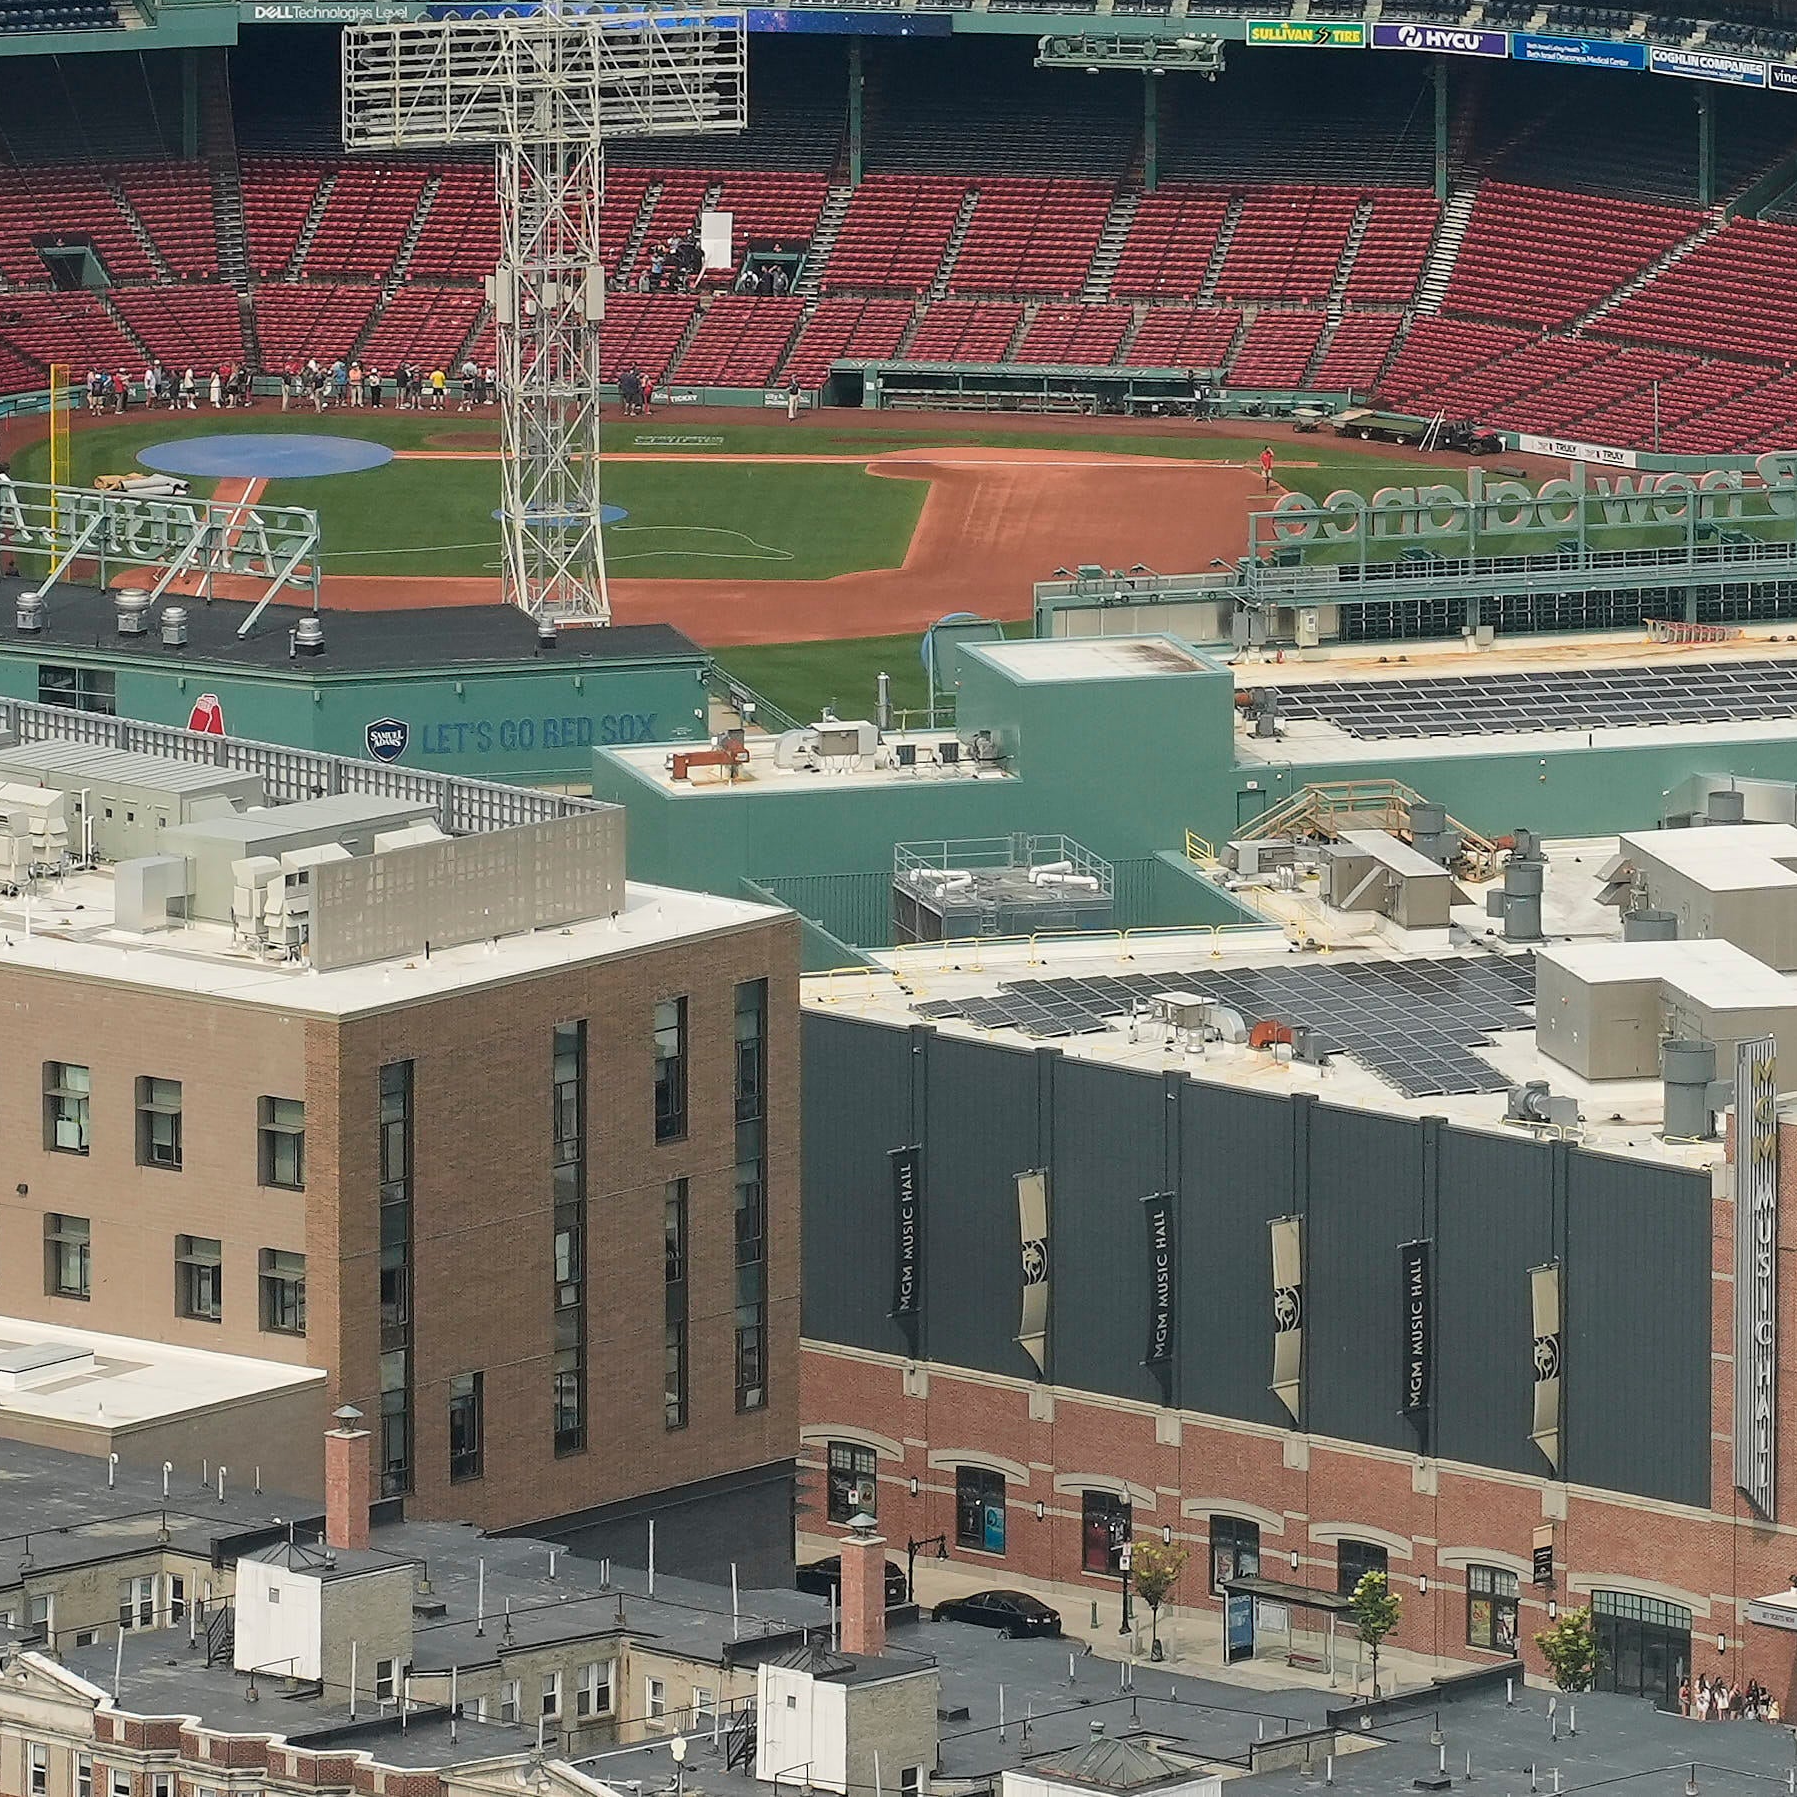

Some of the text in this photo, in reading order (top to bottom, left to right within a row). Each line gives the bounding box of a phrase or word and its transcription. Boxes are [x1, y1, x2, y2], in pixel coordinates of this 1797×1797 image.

[1251, 24, 1361, 42] SULLIVAN TIRE
[1427, 32, 1481, 50] HYCU
[1653, 51, 1699, 67] COGHLIN
[1700, 57, 1764, 76] COMPANIES
[370, 729, 404, 741] SAMUEL
[373, 736, 401, 748] ADAMS
[422, 713, 657, 754] LET'S GO RED SOX
[1751, 1057, 1777, 1169] MGM
[900, 1164, 914, 1311] MGM MUSIC HALL
[1154, 1210, 1168, 1358] MGM MUSIC HALL
[1754, 1183, 1775, 1347] MUSIC
[1410, 1257, 1423, 1407] MGM MUSIC HALL
